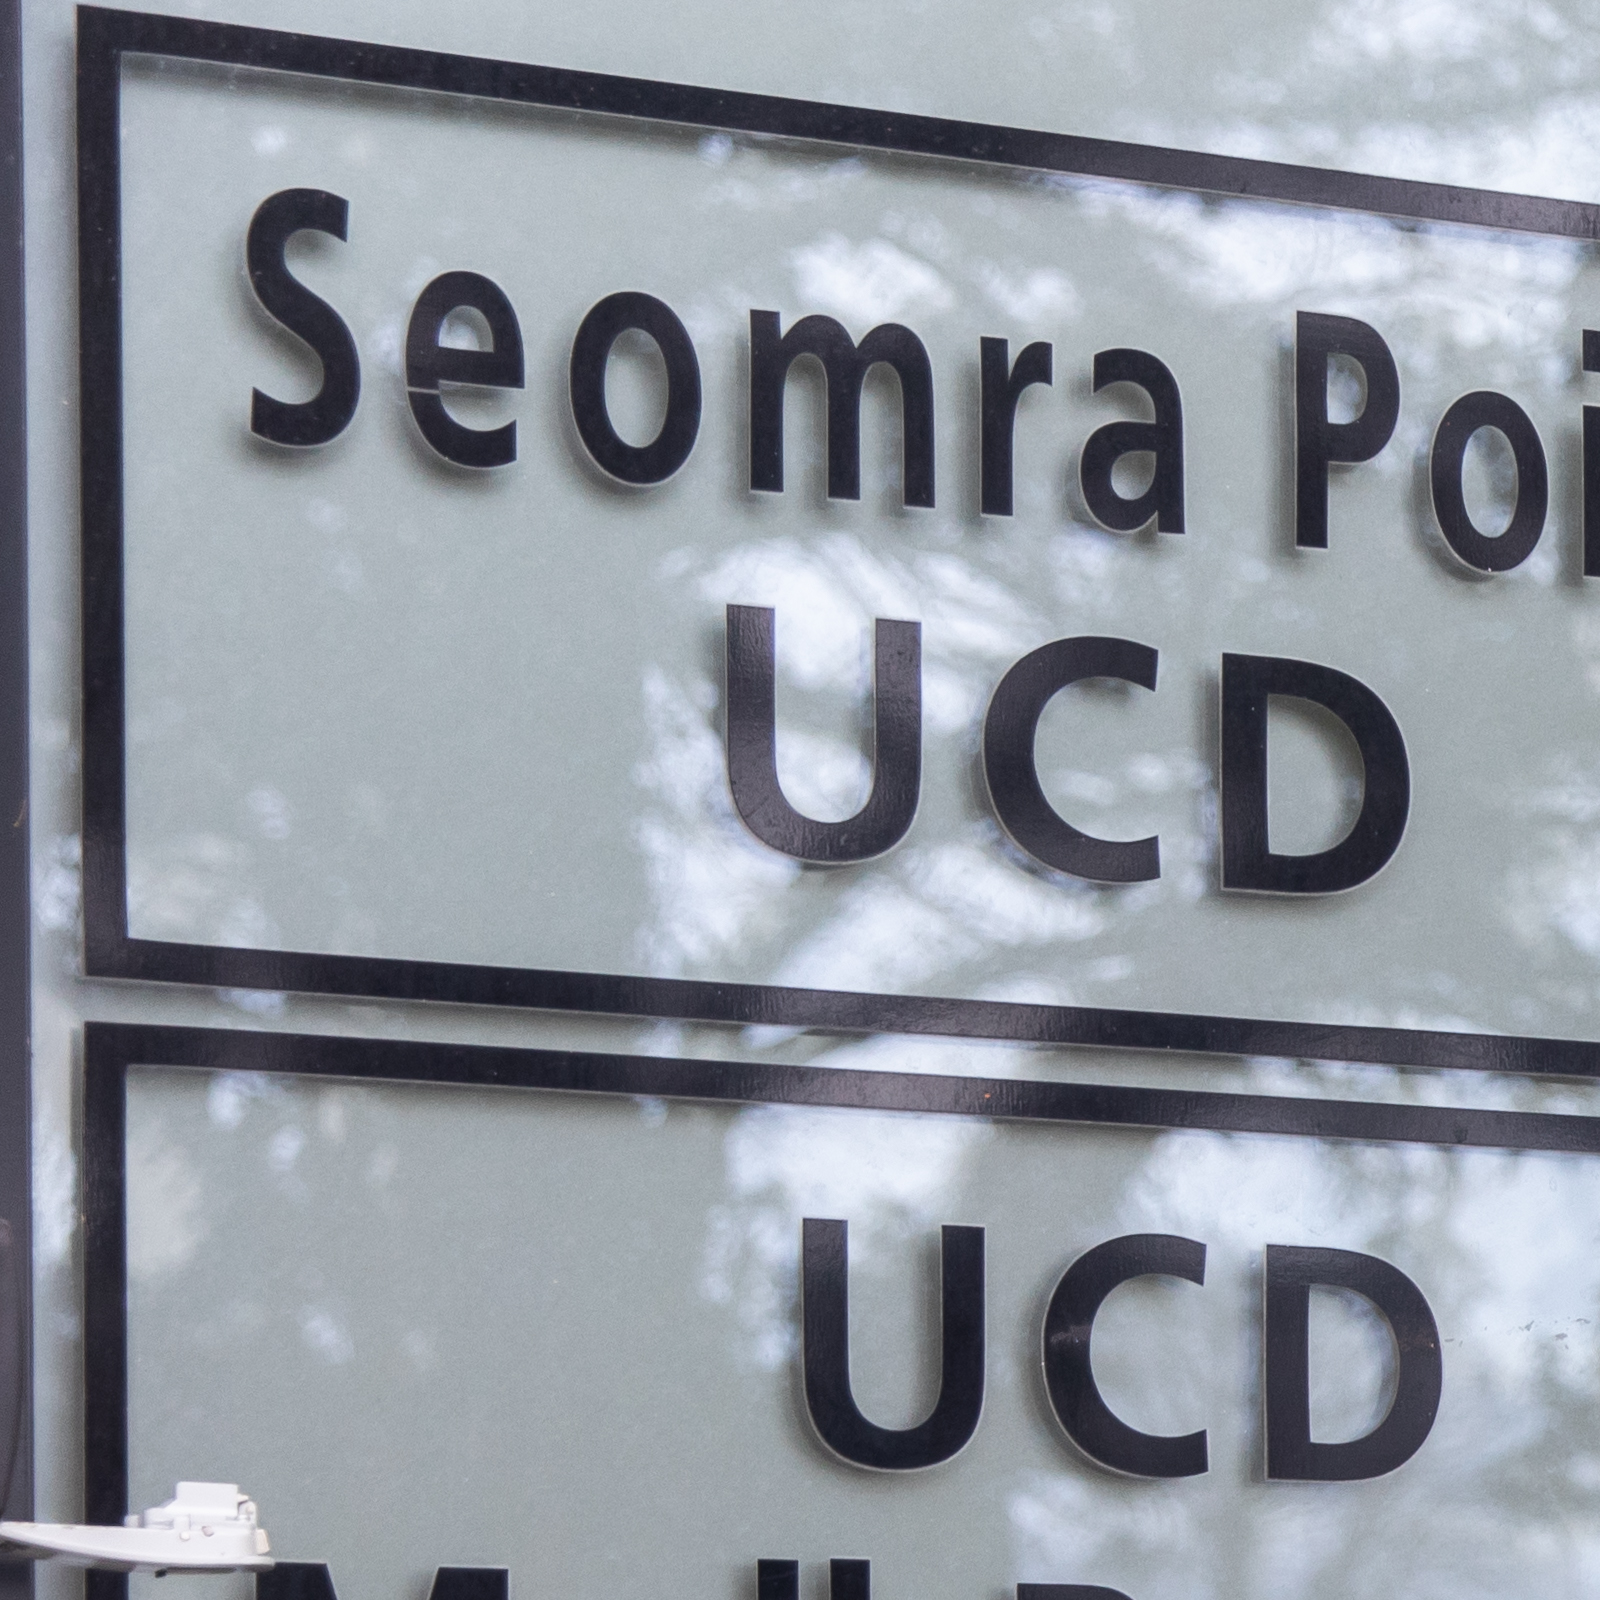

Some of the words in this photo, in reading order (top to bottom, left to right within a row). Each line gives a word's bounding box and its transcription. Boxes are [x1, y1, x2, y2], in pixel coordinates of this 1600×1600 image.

[247, 187, 1187, 536] Seomra
[726, 605, 1411, 895] UCD
[801, 1218, 1442, 1480] UCD
